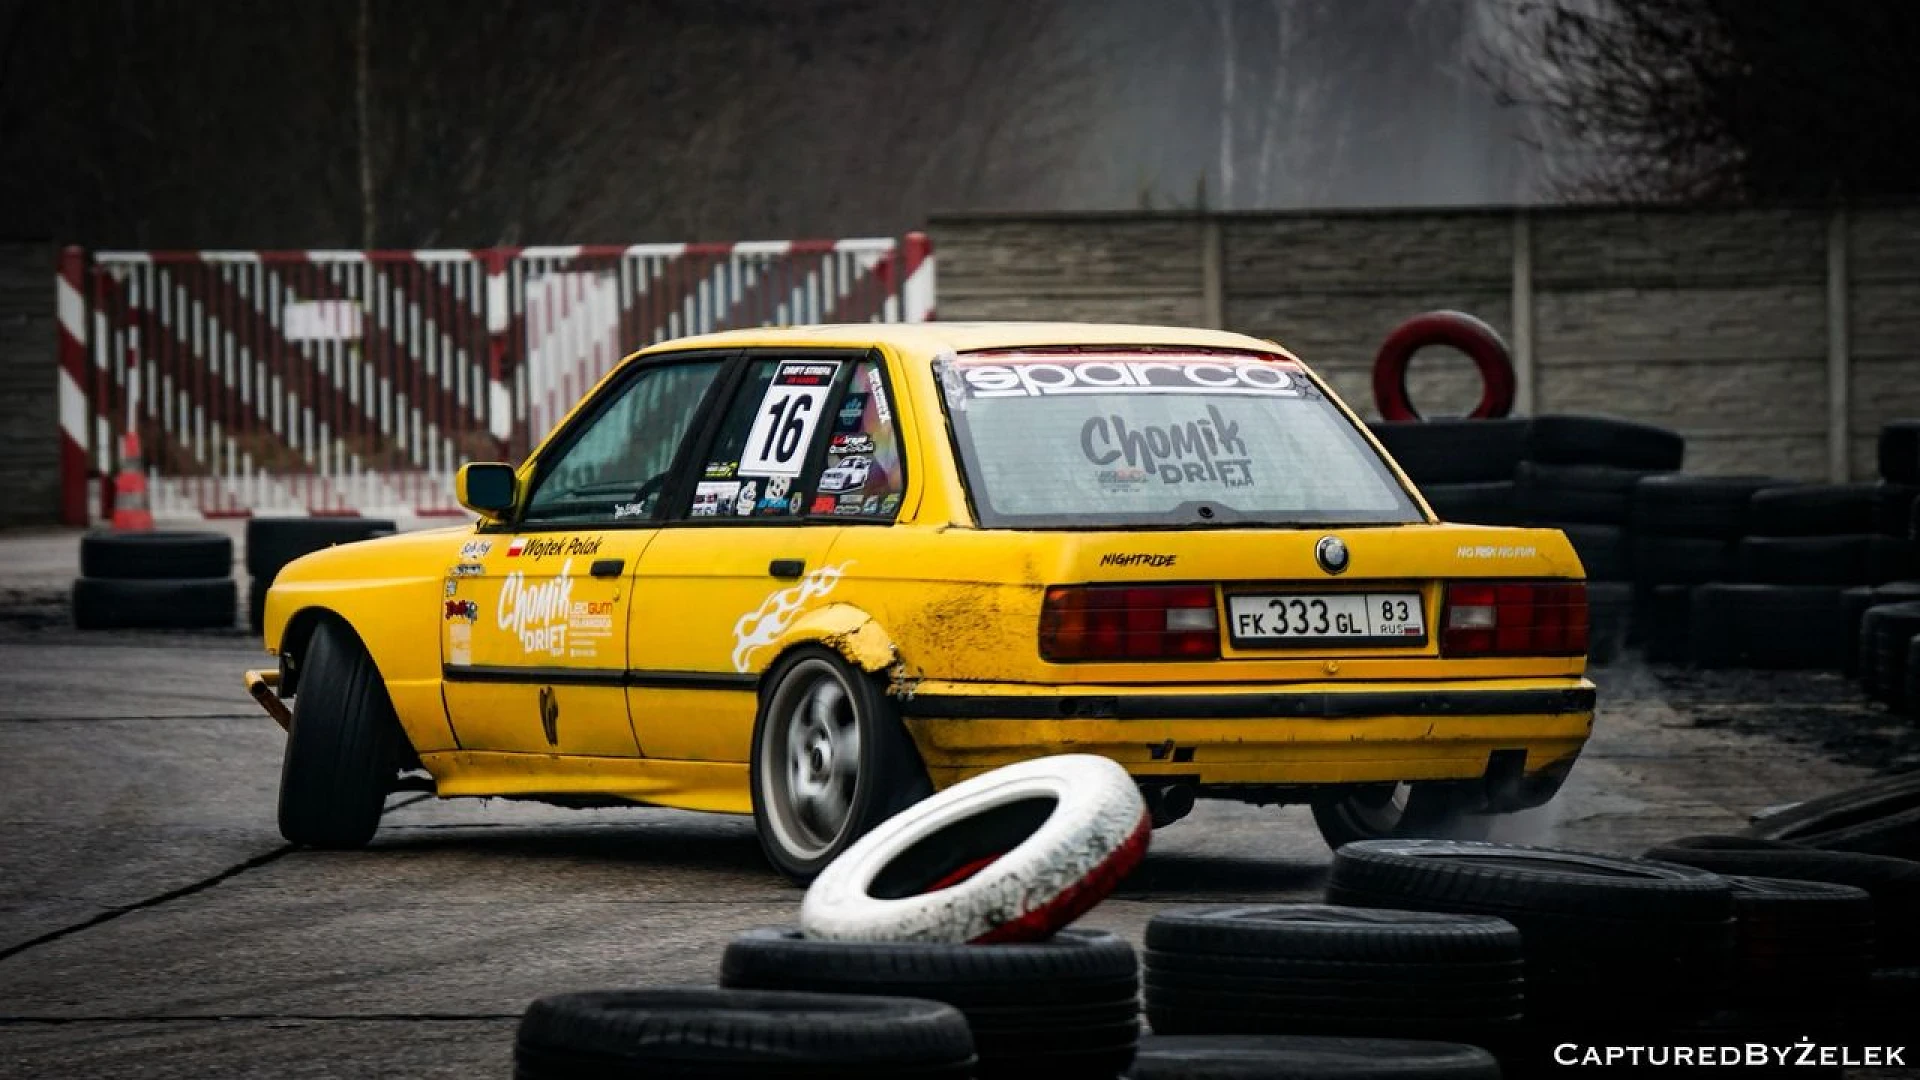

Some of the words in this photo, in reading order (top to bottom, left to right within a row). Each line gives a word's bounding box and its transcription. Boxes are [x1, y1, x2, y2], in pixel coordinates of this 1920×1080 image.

[965, 362, 1292, 397] sparco
[759, 393, 813, 463] 16
[1081, 404, 1249, 476] Chomik
[1158, 458, 1253, 485] DRIFT
[522, 537, 566, 561] Wojtek
[564, 536, 603, 555] Polak
[1100, 553, 1177, 567] NIGHTRIDE
[1457, 545, 1474, 558] NO
[1498, 546, 1513, 558] NO
[498, 557, 574, 642] Chomik
[1239, 614, 1266, 635] FK
[1268, 599, 1330, 635] 333
[1336, 613, 1363, 634] GL
[1381, 600, 1409, 622] 83
[1380, 624, 1404, 634] RUS
[523, 623, 568, 655] DRIFT
